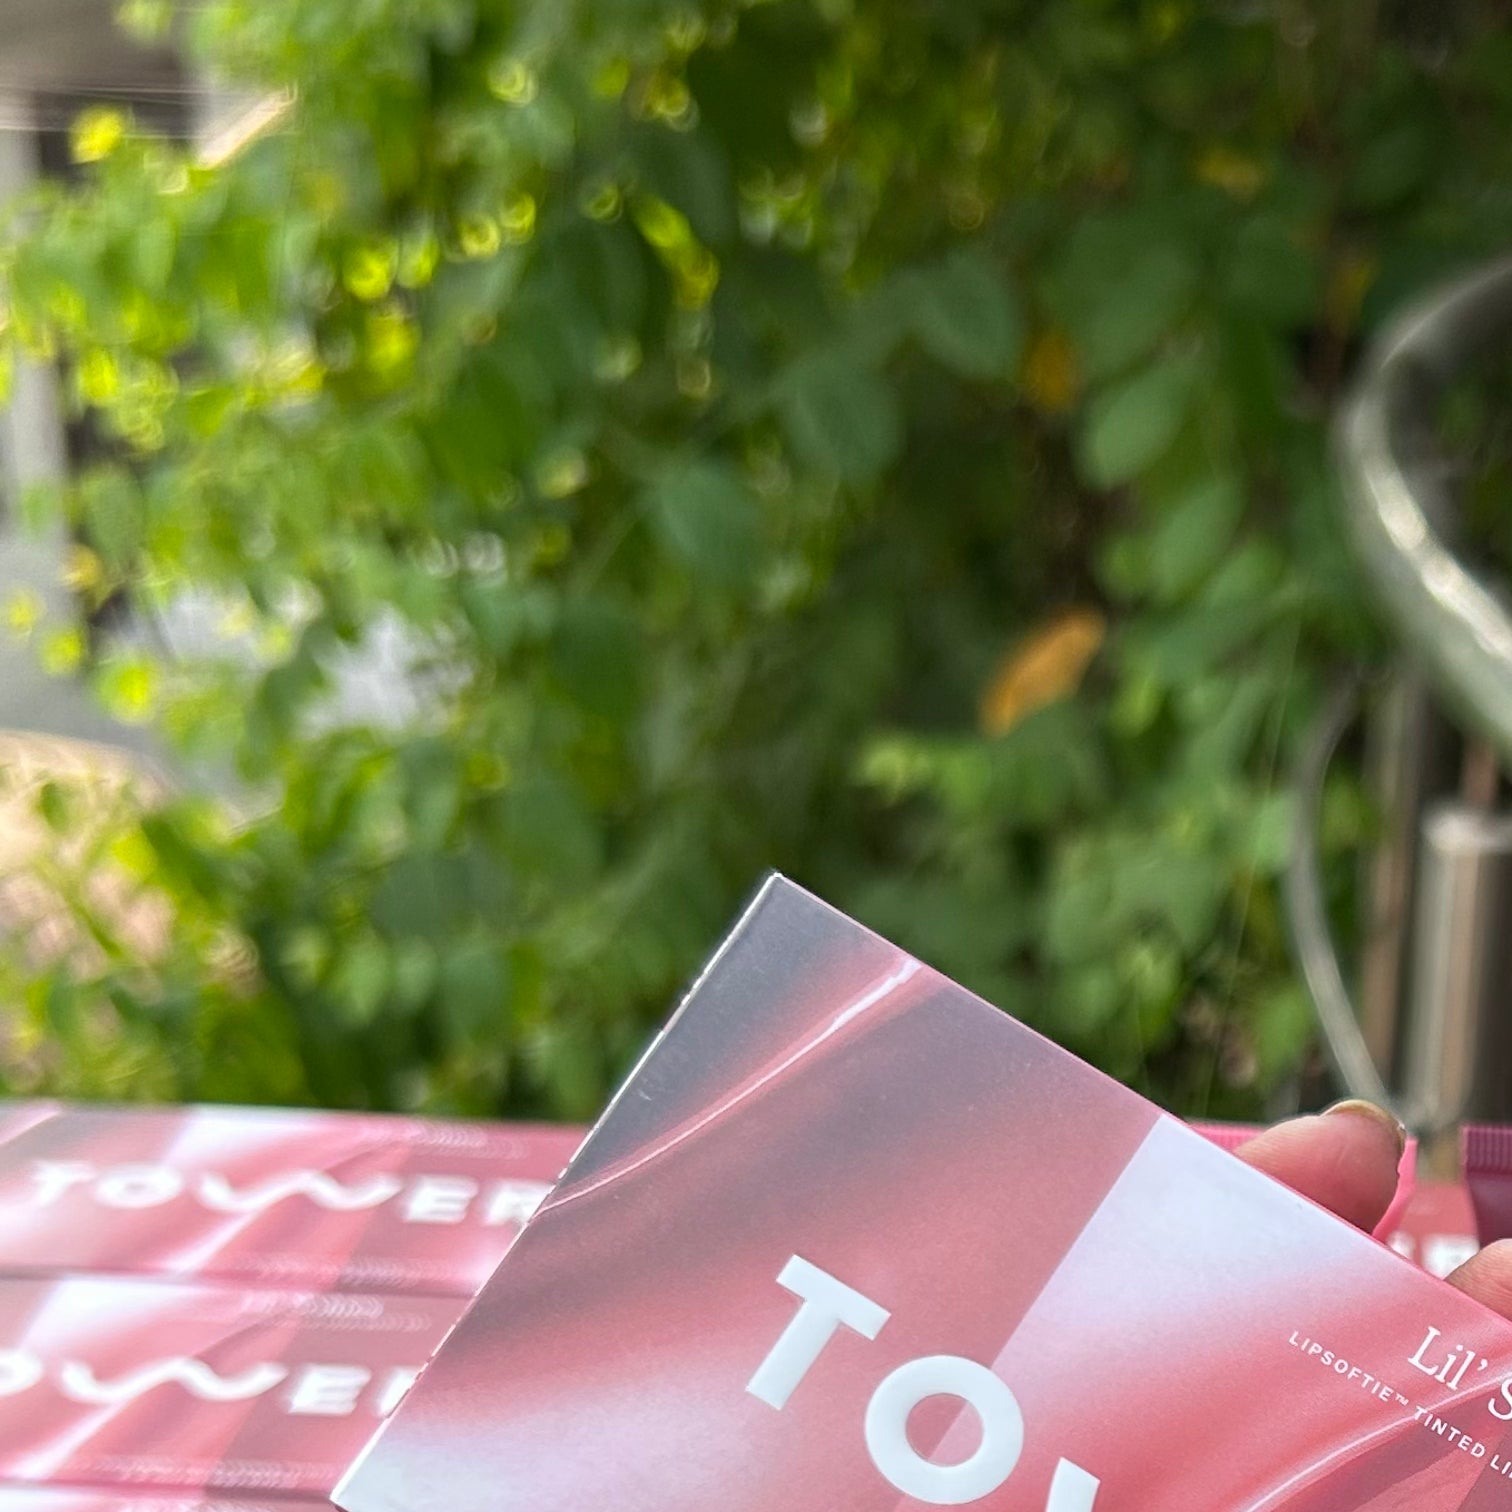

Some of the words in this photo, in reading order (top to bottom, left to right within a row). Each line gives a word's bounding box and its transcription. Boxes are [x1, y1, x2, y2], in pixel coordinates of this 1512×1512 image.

[30, 1161, 558, 1226] TOWER
[0, 1352, 428, 1416] WE
[1413, 1405, 1486, 1459] TINTED
